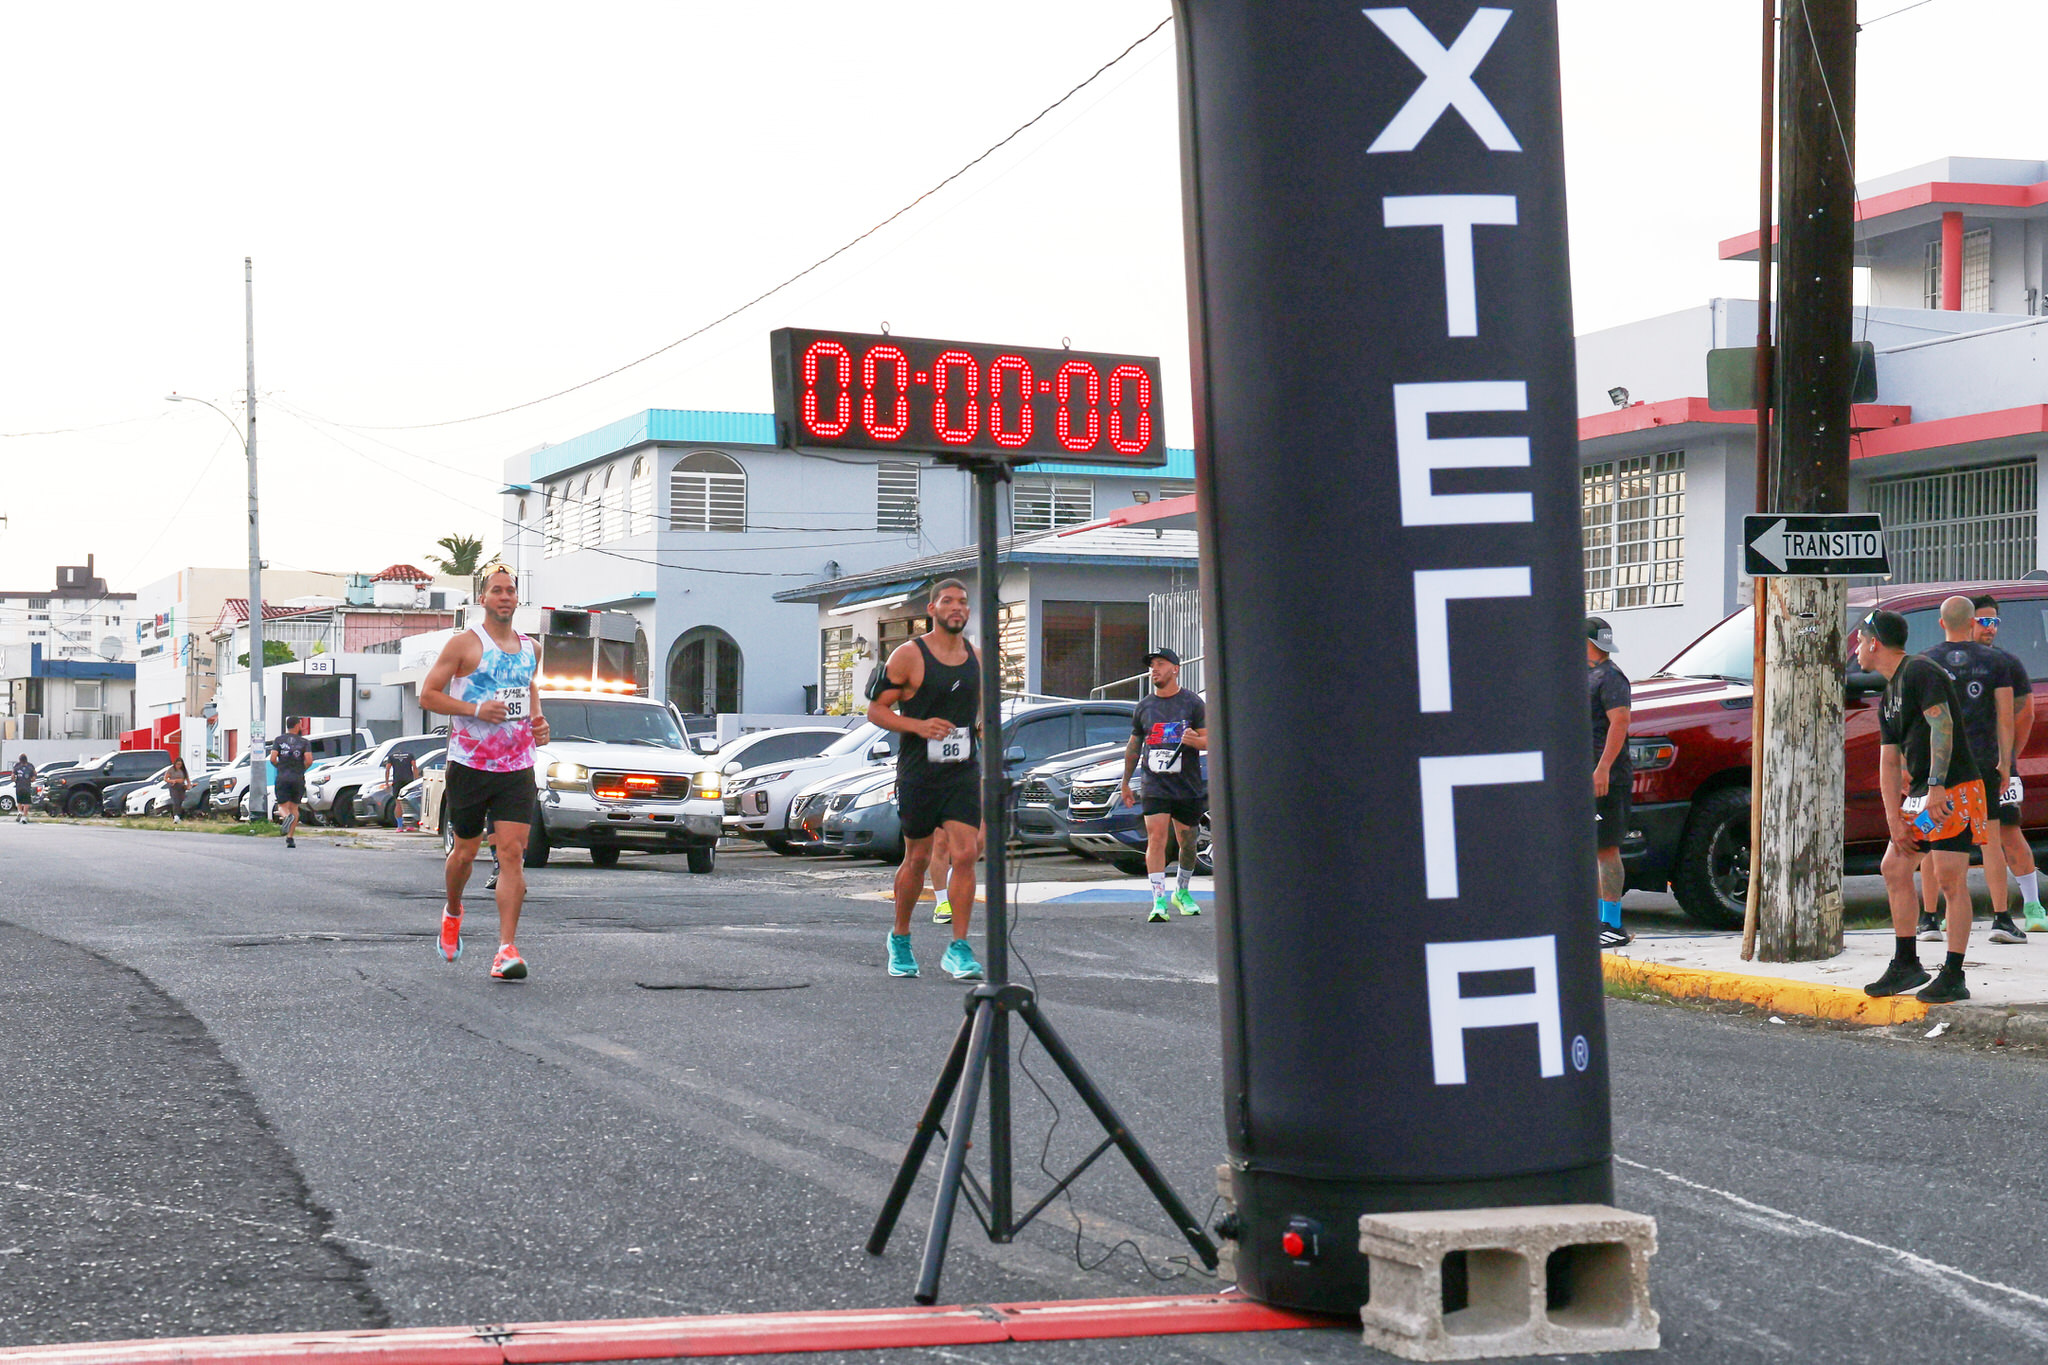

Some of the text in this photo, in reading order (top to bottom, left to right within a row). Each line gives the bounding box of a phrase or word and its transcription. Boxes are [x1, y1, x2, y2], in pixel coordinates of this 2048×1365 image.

[1782, 533, 1877, 556] TRANSITO
[312, 662, 327, 671] 38
[1151, 721, 1181, 738] 5K
[943, 743, 960, 757] 86
